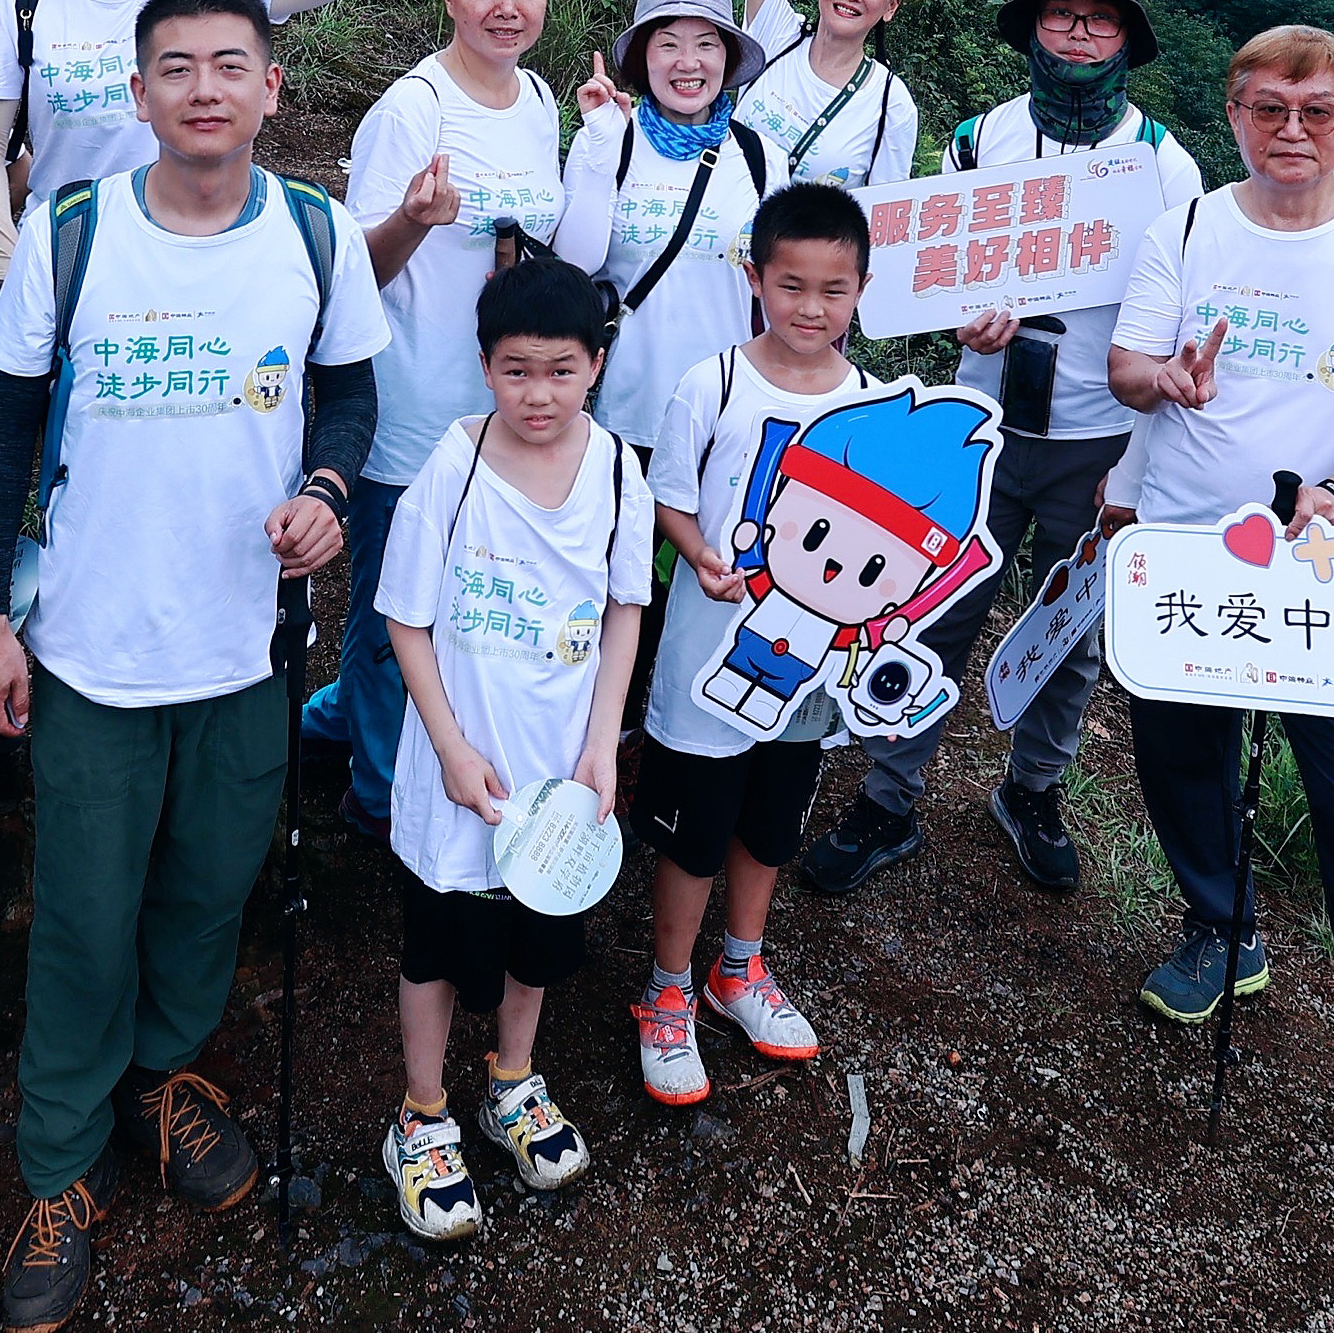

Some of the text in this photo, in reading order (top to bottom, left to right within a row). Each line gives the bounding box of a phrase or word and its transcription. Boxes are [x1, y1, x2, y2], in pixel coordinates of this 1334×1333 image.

[40, 55, 137, 87] 中海同
[47, 82, 130, 114] 徒步同
[469, 188, 555, 212] 中海同心
[869, 174, 1070, 248] 服务至臻
[469, 213, 556, 237] 徒同行
[620, 223, 719, 250] 徒步行
[912, 219, 1117, 293] 美好相伴
[1195, 301, 1311, 335] 中海同心
[93, 335, 232, 367] 中海同心
[95, 369, 232, 401] 徒步同行
[1015, 571, 1099, 684] 我爱中
